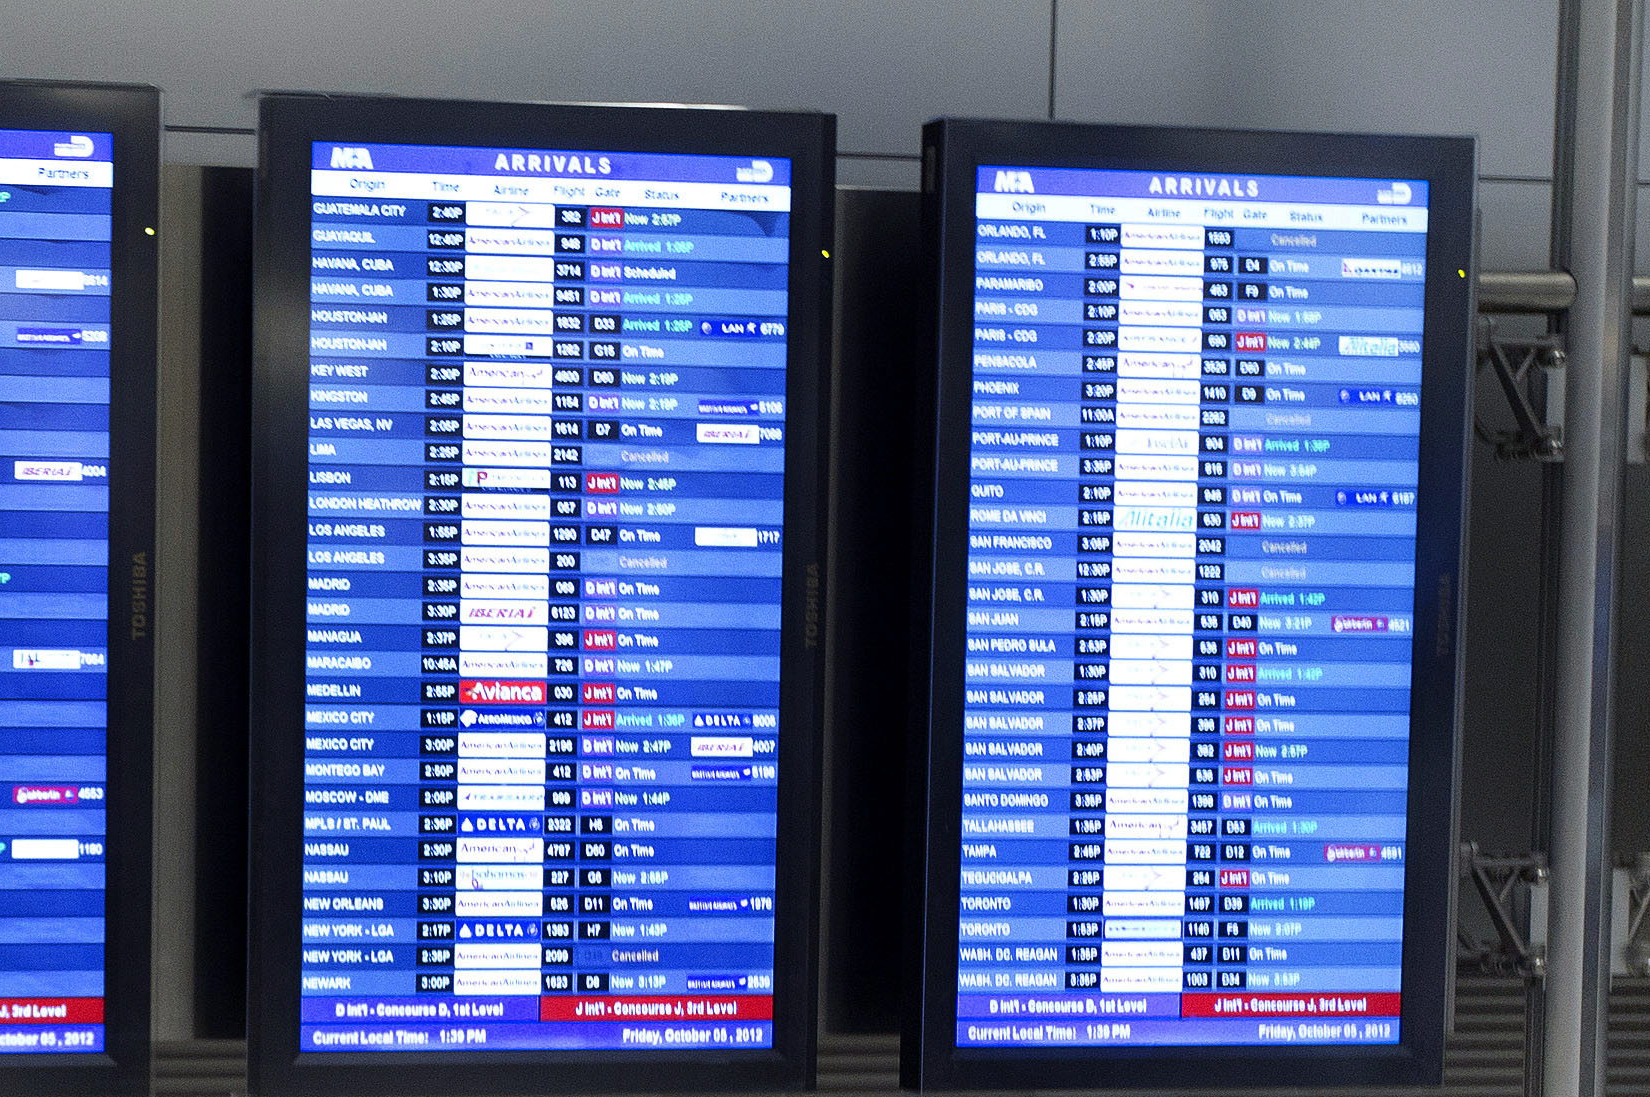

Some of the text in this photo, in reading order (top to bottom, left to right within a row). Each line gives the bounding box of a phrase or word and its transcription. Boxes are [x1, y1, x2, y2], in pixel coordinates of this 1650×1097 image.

[494, 152, 611, 175] ARRIVALS
[37, 168, 89, 180] Partners
[349, 179, 769, 204] Origin Time Gate Partners
[1148, 176, 1259, 198] ARRIVALS
[312, 201, 406, 217] GUATEMALA CITY
[1011, 202, 1267, 220] Origin Time Gate
[361, 257, 394, 271] CUBA
[310, 363, 369, 378] KEY WEST
[973, 380, 1020, 394] PHOENIX
[310, 389, 368, 403] KINGSTON
[309, 416, 333, 430] LAS
[309, 470, 351, 484] LISBON
[970, 483, 1302, 503] QUITO On Time
[308, 496, 422, 511] LONDON HEATHROW
[1117, 507, 1193, 529] Alitalia
[308, 523, 386, 537] LOS ANGELES
[307, 577, 351, 591] MADRID
[131, 551, 148, 640] TOSHIBA
[306, 629, 659, 647] MANAGUA On Time
[306, 681, 544, 701] MEDELLIN Avianca
[305, 737, 375, 751] MEXICO CITY
[305, 763, 385, 777] MONTEGO BAY
[304, 789, 357, 803] MOSCOW
[476, 817, 526, 831] DELTA
[961, 844, 997, 857] TAMPA
[303, 897, 331, 910] NEW
[303, 923, 524, 937] NEW YORK LGA DELTA
[301, 976, 351, 990] NEWARK
[11, 1003, 32, 1018] 3rd
[32, 1004, 67, 1018] Level
[334, 1002, 504, 1017] D Concourse Level
[1213, 997, 1222, 1013] J
[1336, 998, 1367, 1012] Level
[312, 1031, 359, 1045] Current
[359, 1031, 394, 1046] Local
[466, 1028, 487, 1044] PM
[622, 1028, 711, 1044] Friday, October
[1111, 1023, 1131, 1040] PM
[1257, 1023, 1342, 1040] Friday, October
